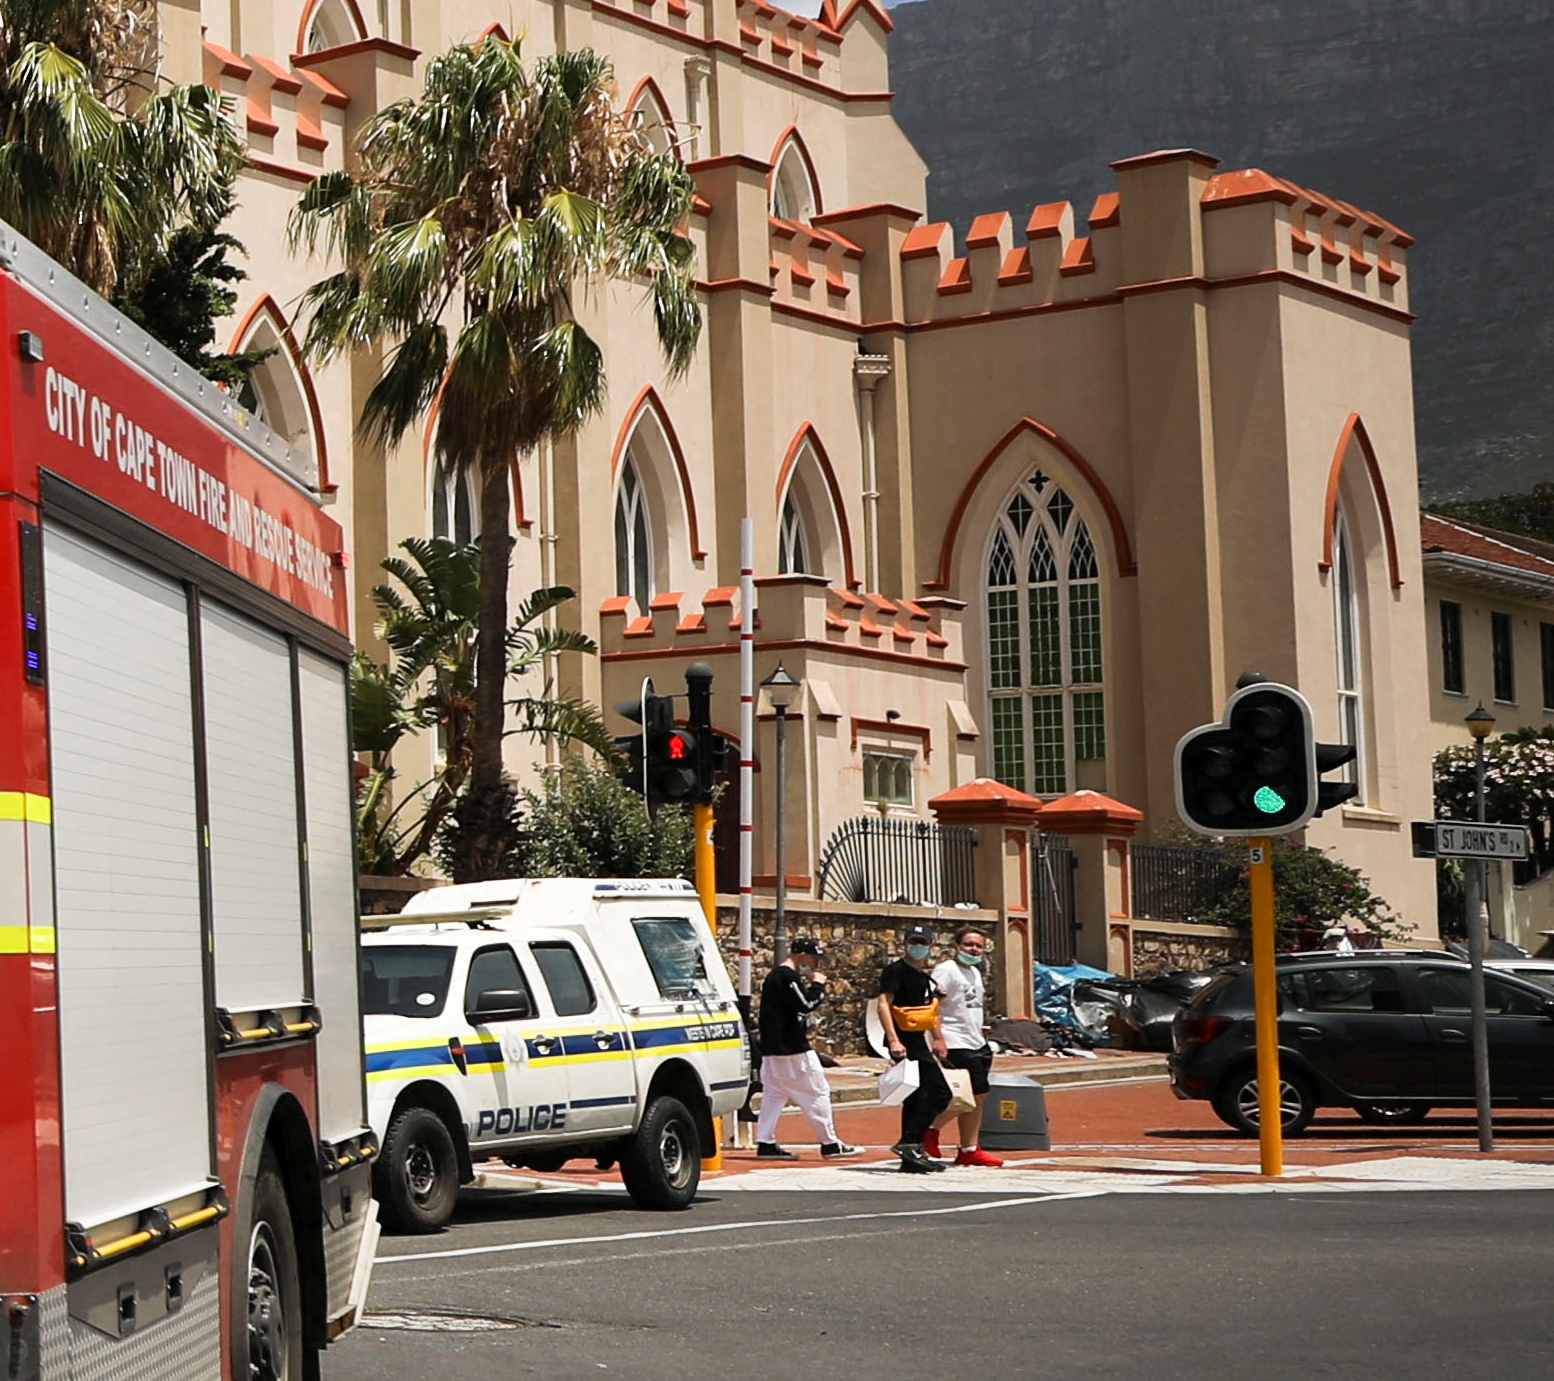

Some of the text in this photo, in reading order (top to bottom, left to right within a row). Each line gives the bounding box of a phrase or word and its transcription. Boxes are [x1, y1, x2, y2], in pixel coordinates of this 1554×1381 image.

[45, 366, 335, 601] CITY OF CAPE TOWN FIRE AND RESCUE SERVICE
[1443, 829, 1455, 849] ST
[1461, 830, 1496, 851] JOHN'S
[1252, 849, 1261, 862] 5
[477, 1103, 567, 1136] POLICE
